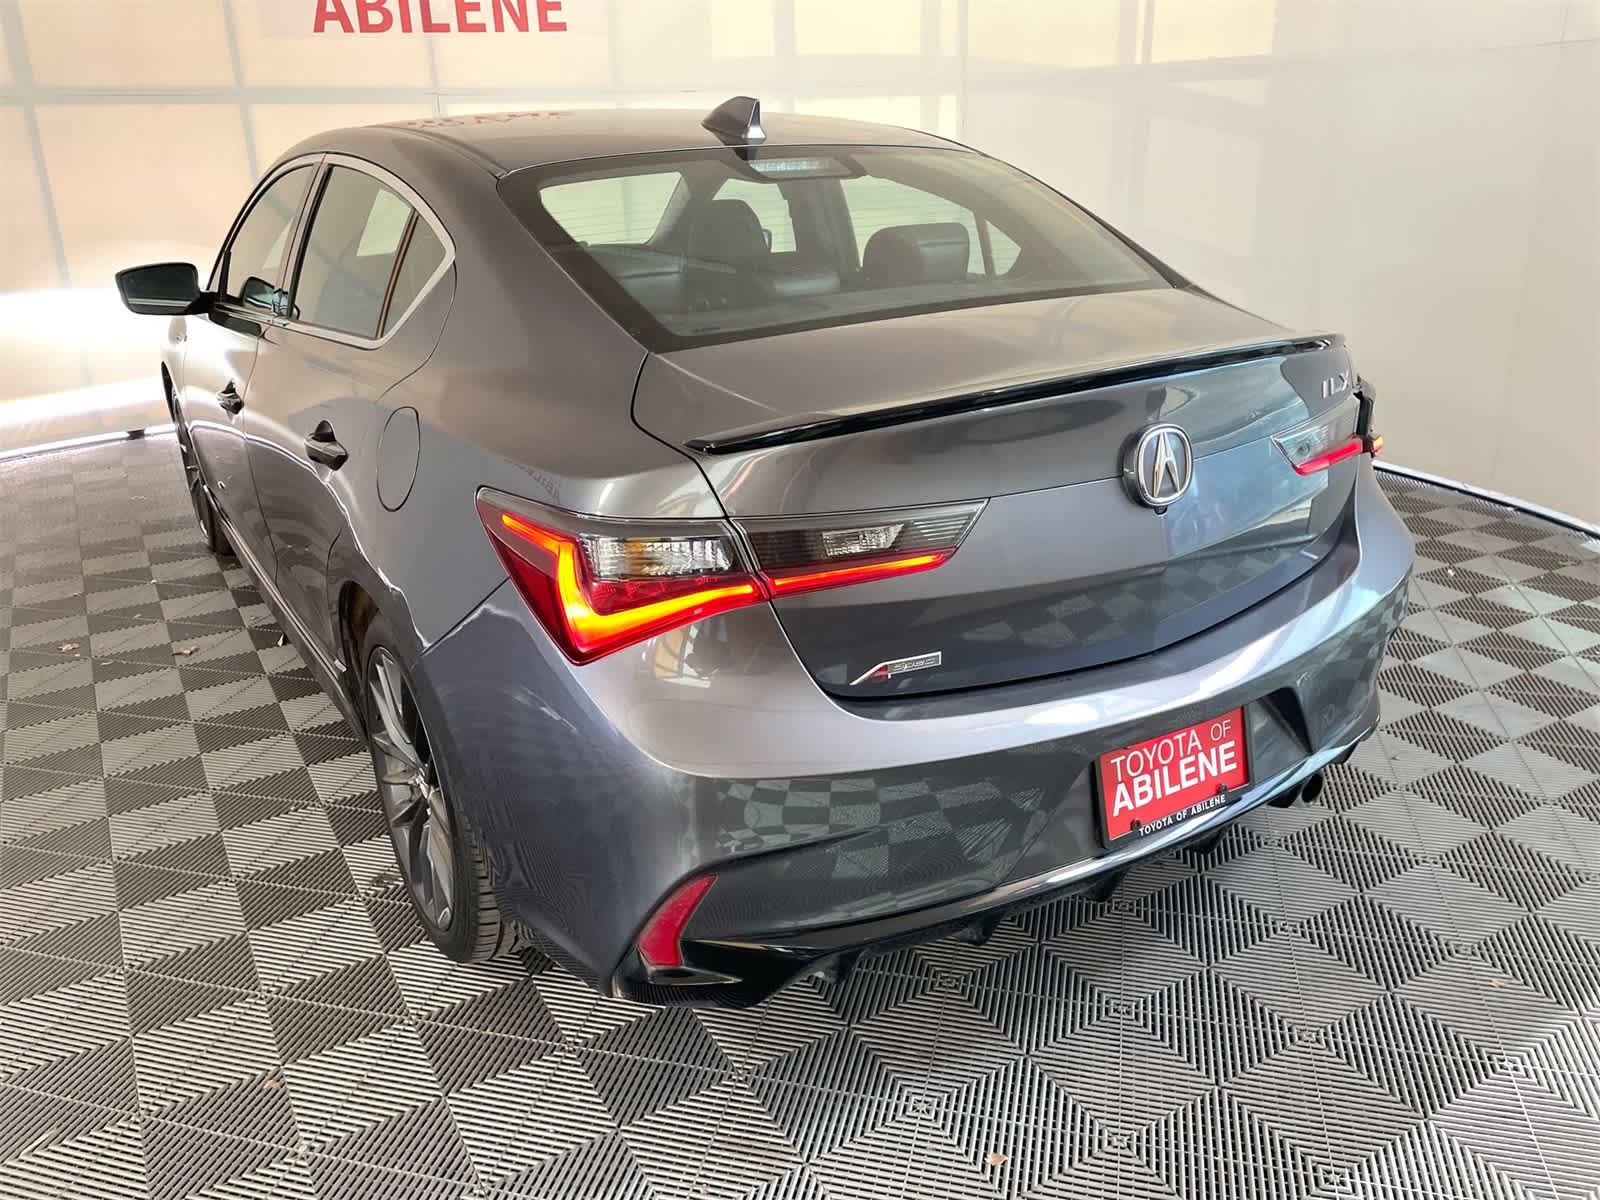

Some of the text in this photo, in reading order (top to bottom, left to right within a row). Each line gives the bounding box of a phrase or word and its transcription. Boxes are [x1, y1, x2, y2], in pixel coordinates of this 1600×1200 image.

[313, 0, 567, 33] ABILENE
[1110, 719, 1232, 782] TOYOTA OF
[1112, 740, 1237, 817] ABILENE
[1138, 794, 1226, 837] TOYOTA OF ABILENE
